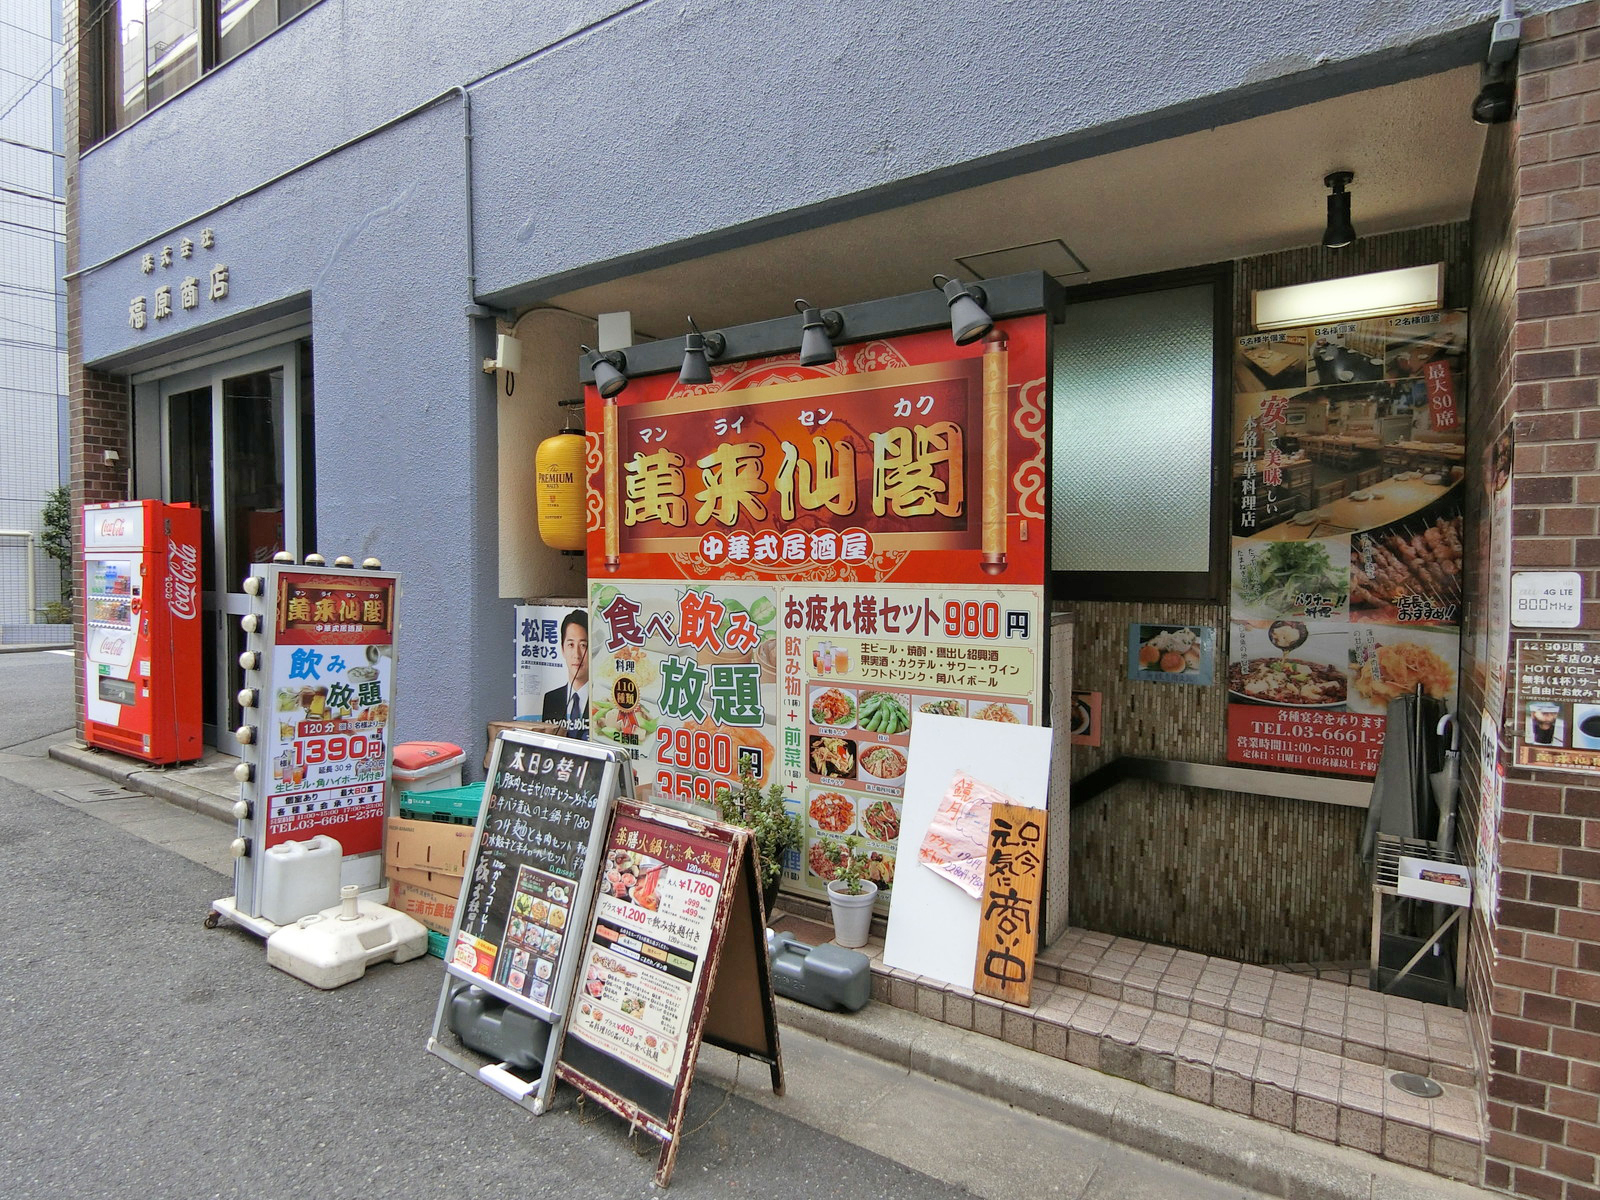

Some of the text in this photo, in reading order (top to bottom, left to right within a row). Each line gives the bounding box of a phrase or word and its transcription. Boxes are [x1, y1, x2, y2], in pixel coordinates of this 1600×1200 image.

[141, 227, 216, 274] 株式会社
[128, 262, 230, 330] 福原商店
[1240, 313, 1441, 346] 6名様半個室 8名様個室 12名様個室
[1428, 364, 1455, 427] 最大80席
[640, 395, 935, 444] マン ライ セン カク
[1259, 395, 1289, 514] 安くて美味しい
[538, 472, 574, 483] PREMIUM
[624, 422, 965, 527] 萬来仙閣
[1241, 415, 1258, 527] 本格中華料理店
[703, 532, 870, 560] 中華式居酒屋
[166, 539, 197, 620] Coca-Cola
[522, 618, 558, 644] 松尾
[602, 589, 761, 654] 食べ飲み
[289, 648, 346, 680] 飲み
[522, 644, 558, 659] あきひろ
[860, 655, 1020, 675] 果実酒・カクテル・サワー・ワイン
[616, 660, 635, 672] 料理
[861, 668, 998, 687] ソフトドリンク・角ハイボール
[1525, 665, 1551, 673] HOT
[1554, 666, 1561, 674] &
[326, 680, 382, 709] 放題
[616, 681, 635, 692] 110
[616, 692, 635, 706] 種類
[658, 655, 765, 727] 放題
[1278, 709, 1384, 729] 各種宴会を承ります
[613, 732, 639, 746] 2時間
[1251, 721, 1386, 745] TEL.03-6661-2
[294, 736, 382, 766] 1390円
[275, 772, 382, 794] 生ビール・角ハイボール付き
[285, 793, 318, 805] 個室あり
[679, 878, 714, 898] ¥1,780
